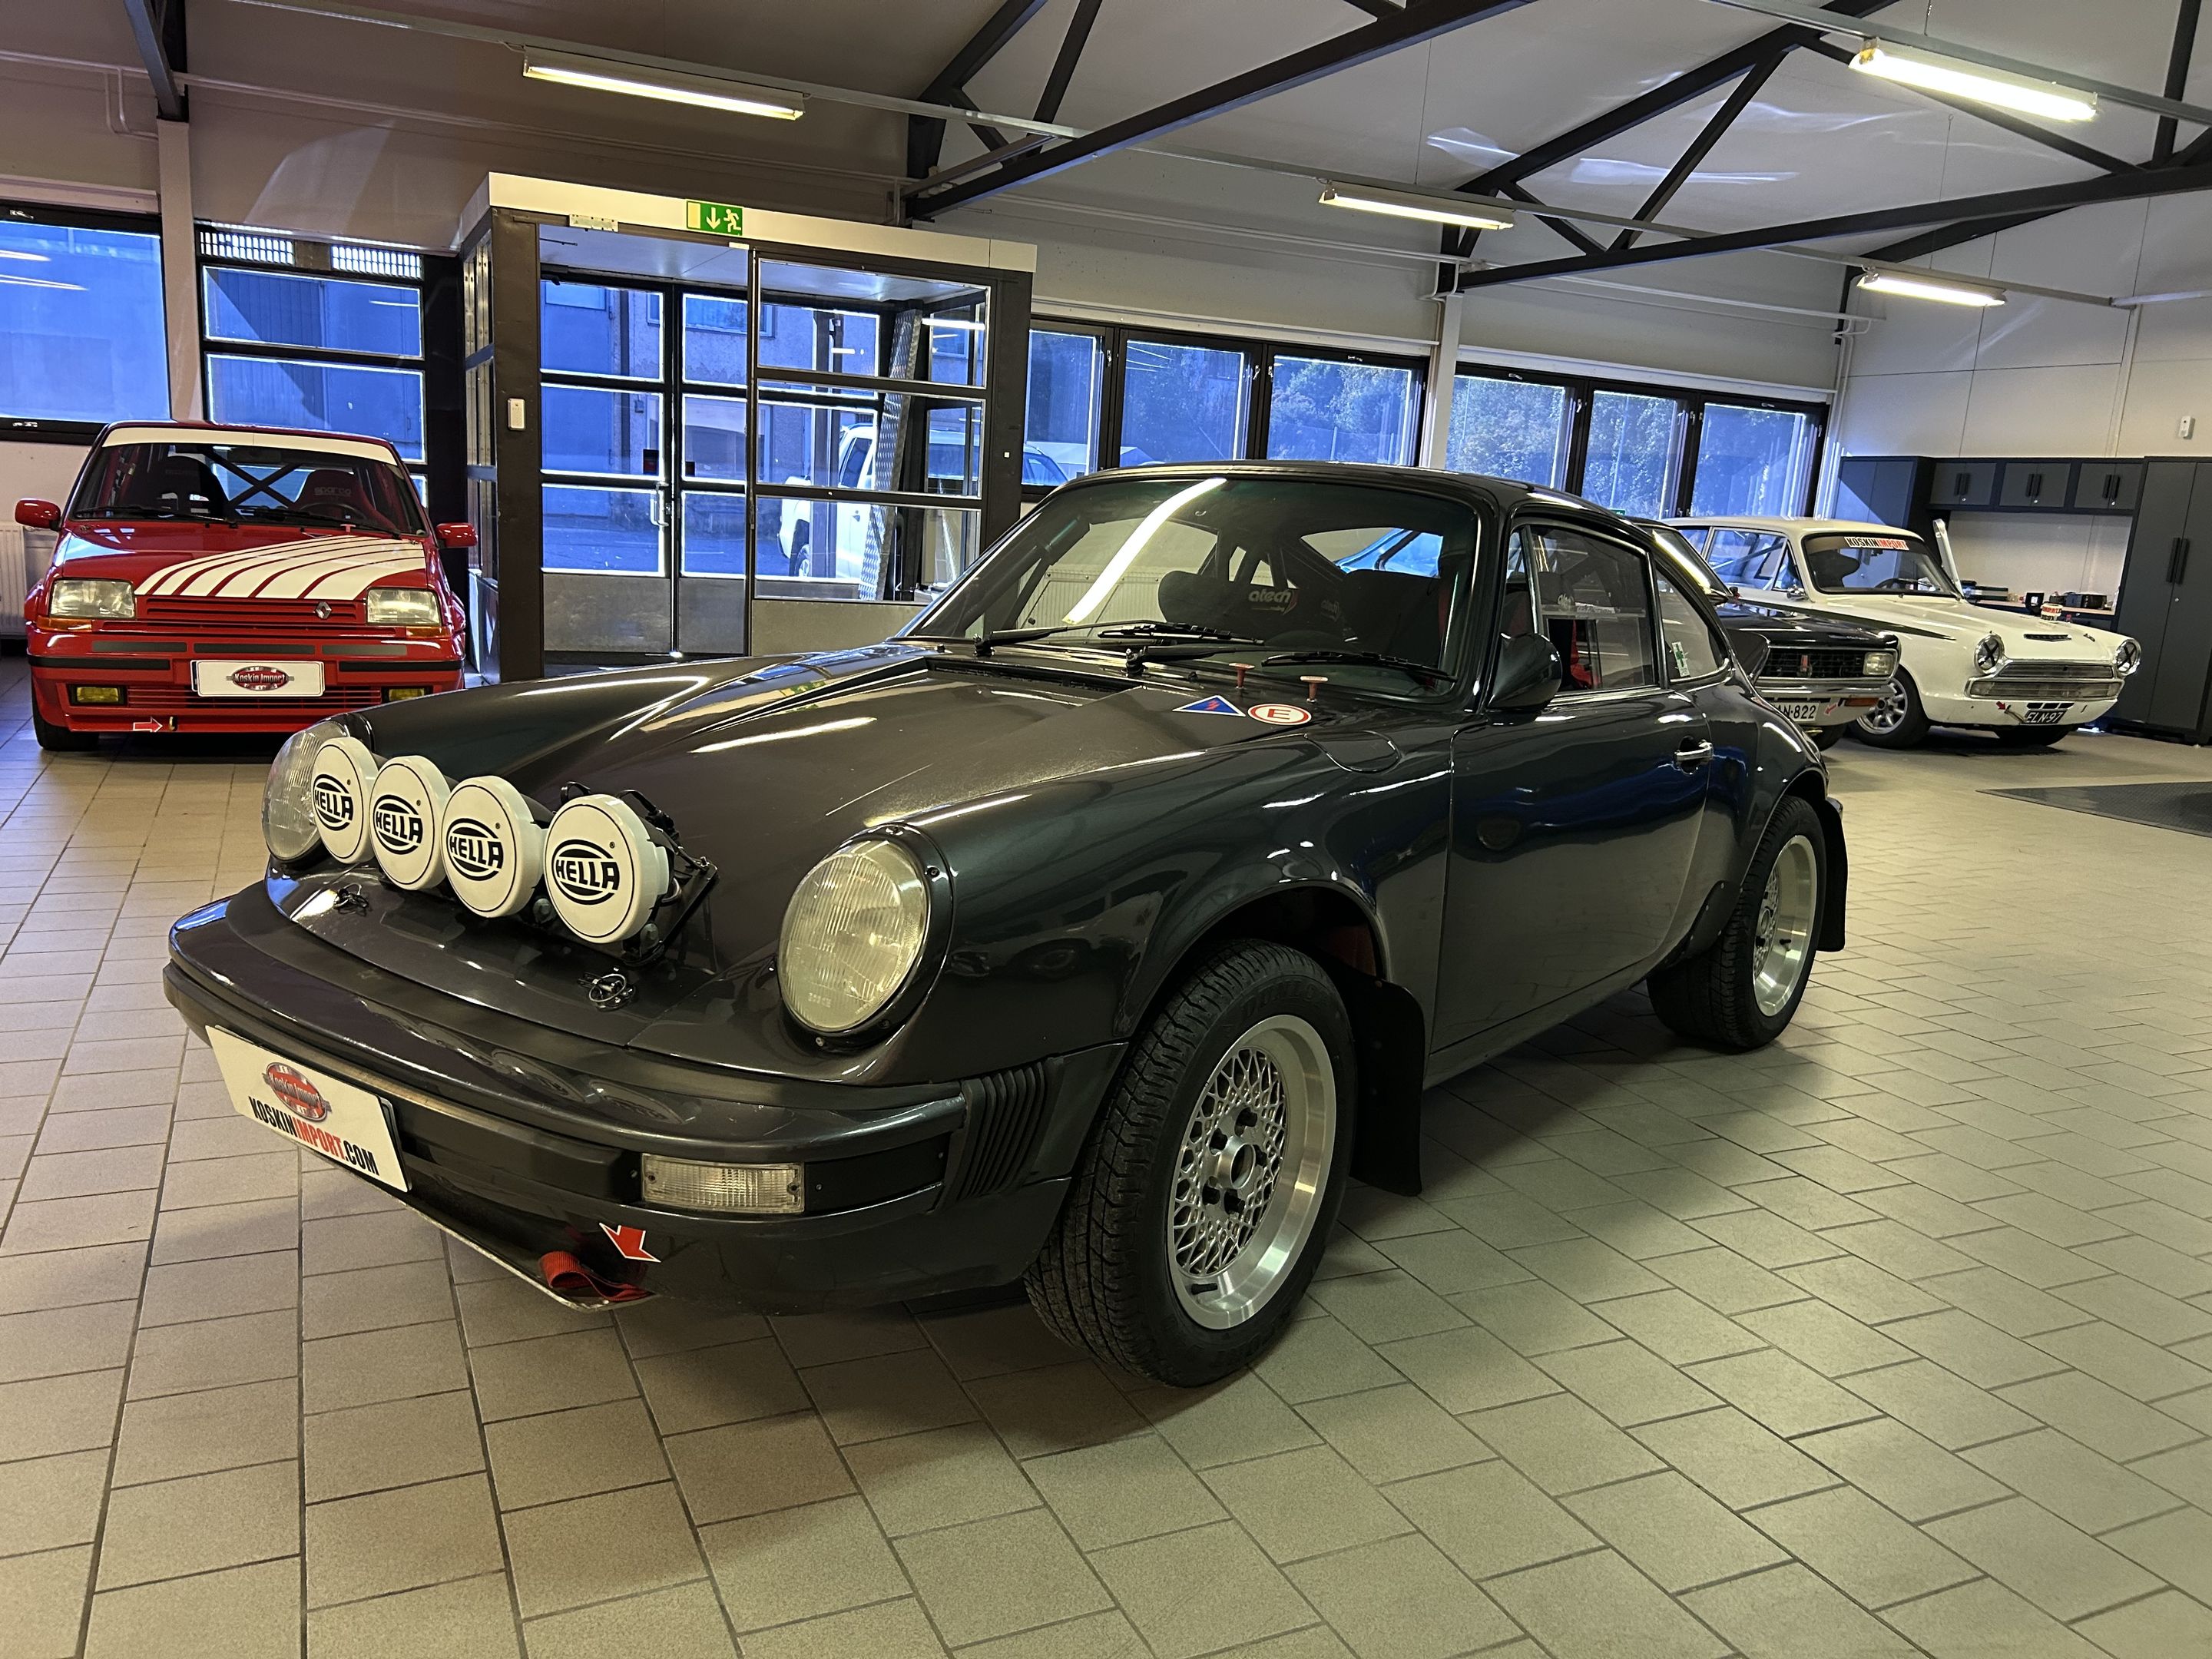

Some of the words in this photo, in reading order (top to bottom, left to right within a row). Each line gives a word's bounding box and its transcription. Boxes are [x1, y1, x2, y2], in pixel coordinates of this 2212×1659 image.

[1846, 538, 1907, 549] KOSKINIMPORT
[314, 790, 353, 821] HELLA
[376, 811, 423, 844] HELLA
[449, 836, 504, 869] HELLA
[555, 859, 620, 891] HELLA
[248, 1096, 379, 1176] KOSKINIMPORT.COM
